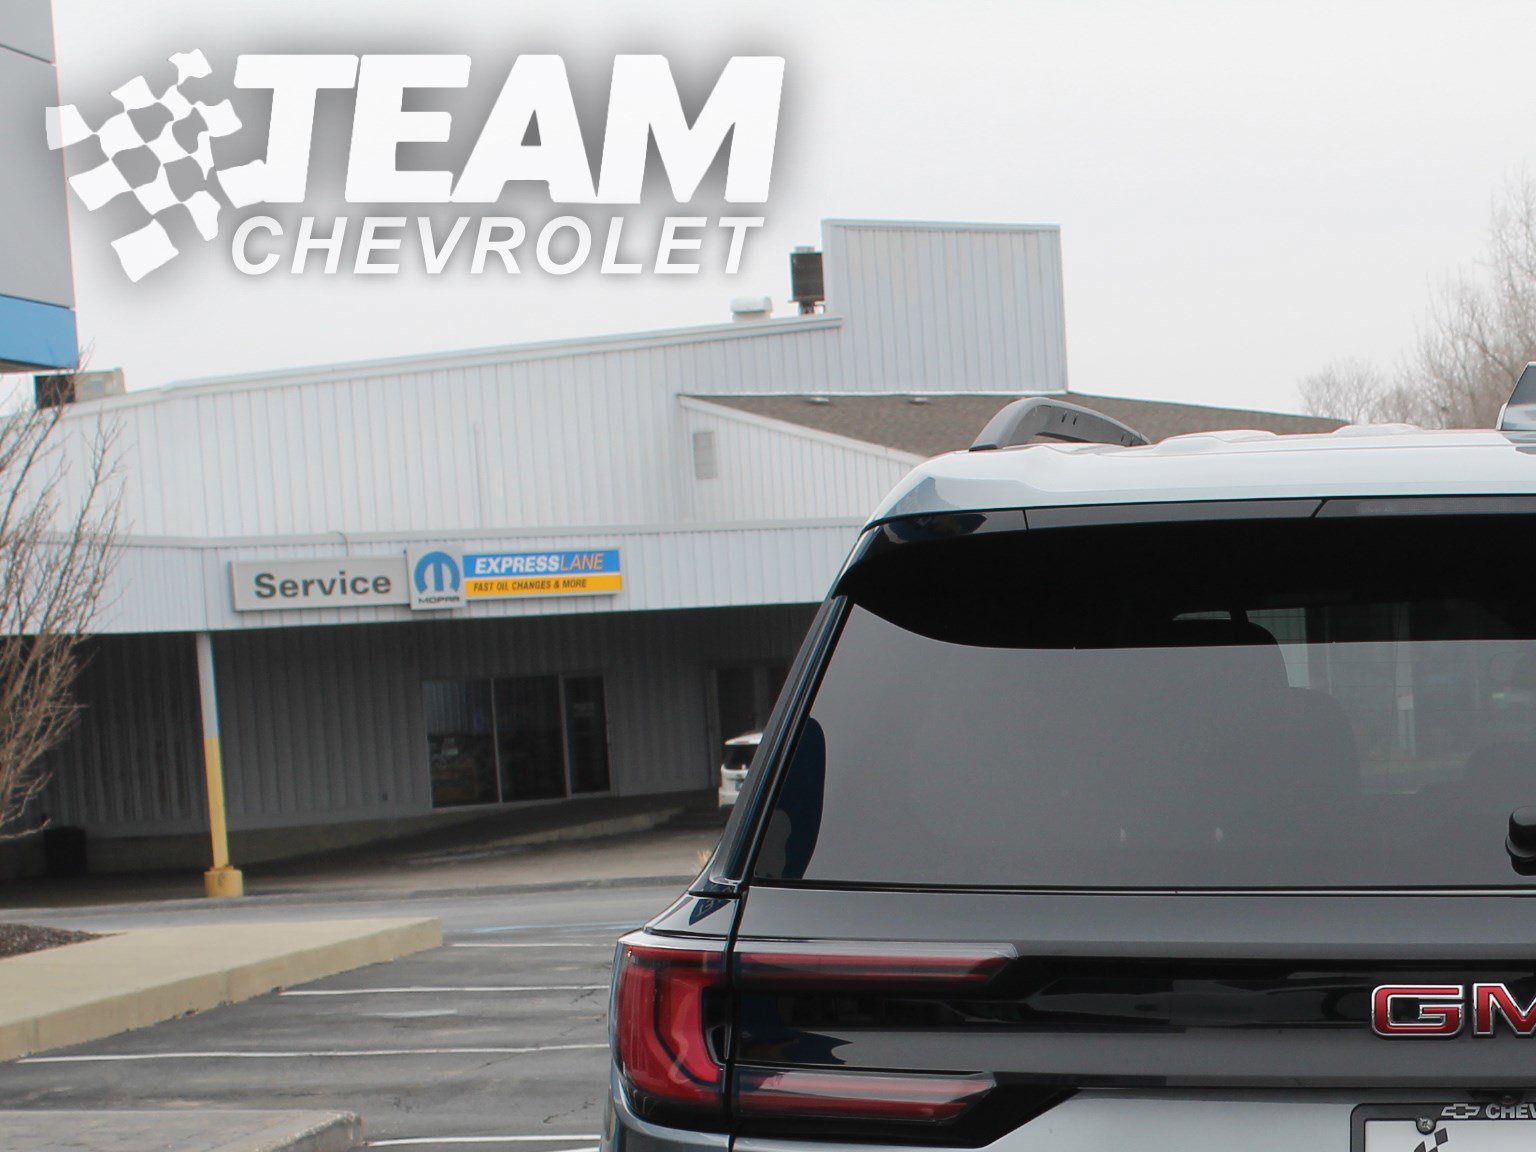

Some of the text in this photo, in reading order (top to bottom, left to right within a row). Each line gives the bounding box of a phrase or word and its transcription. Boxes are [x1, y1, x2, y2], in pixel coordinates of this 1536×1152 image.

[254, 570, 392, 598] Service
[473, 578, 587, 592] FAST OIL CHANGES & MORE
